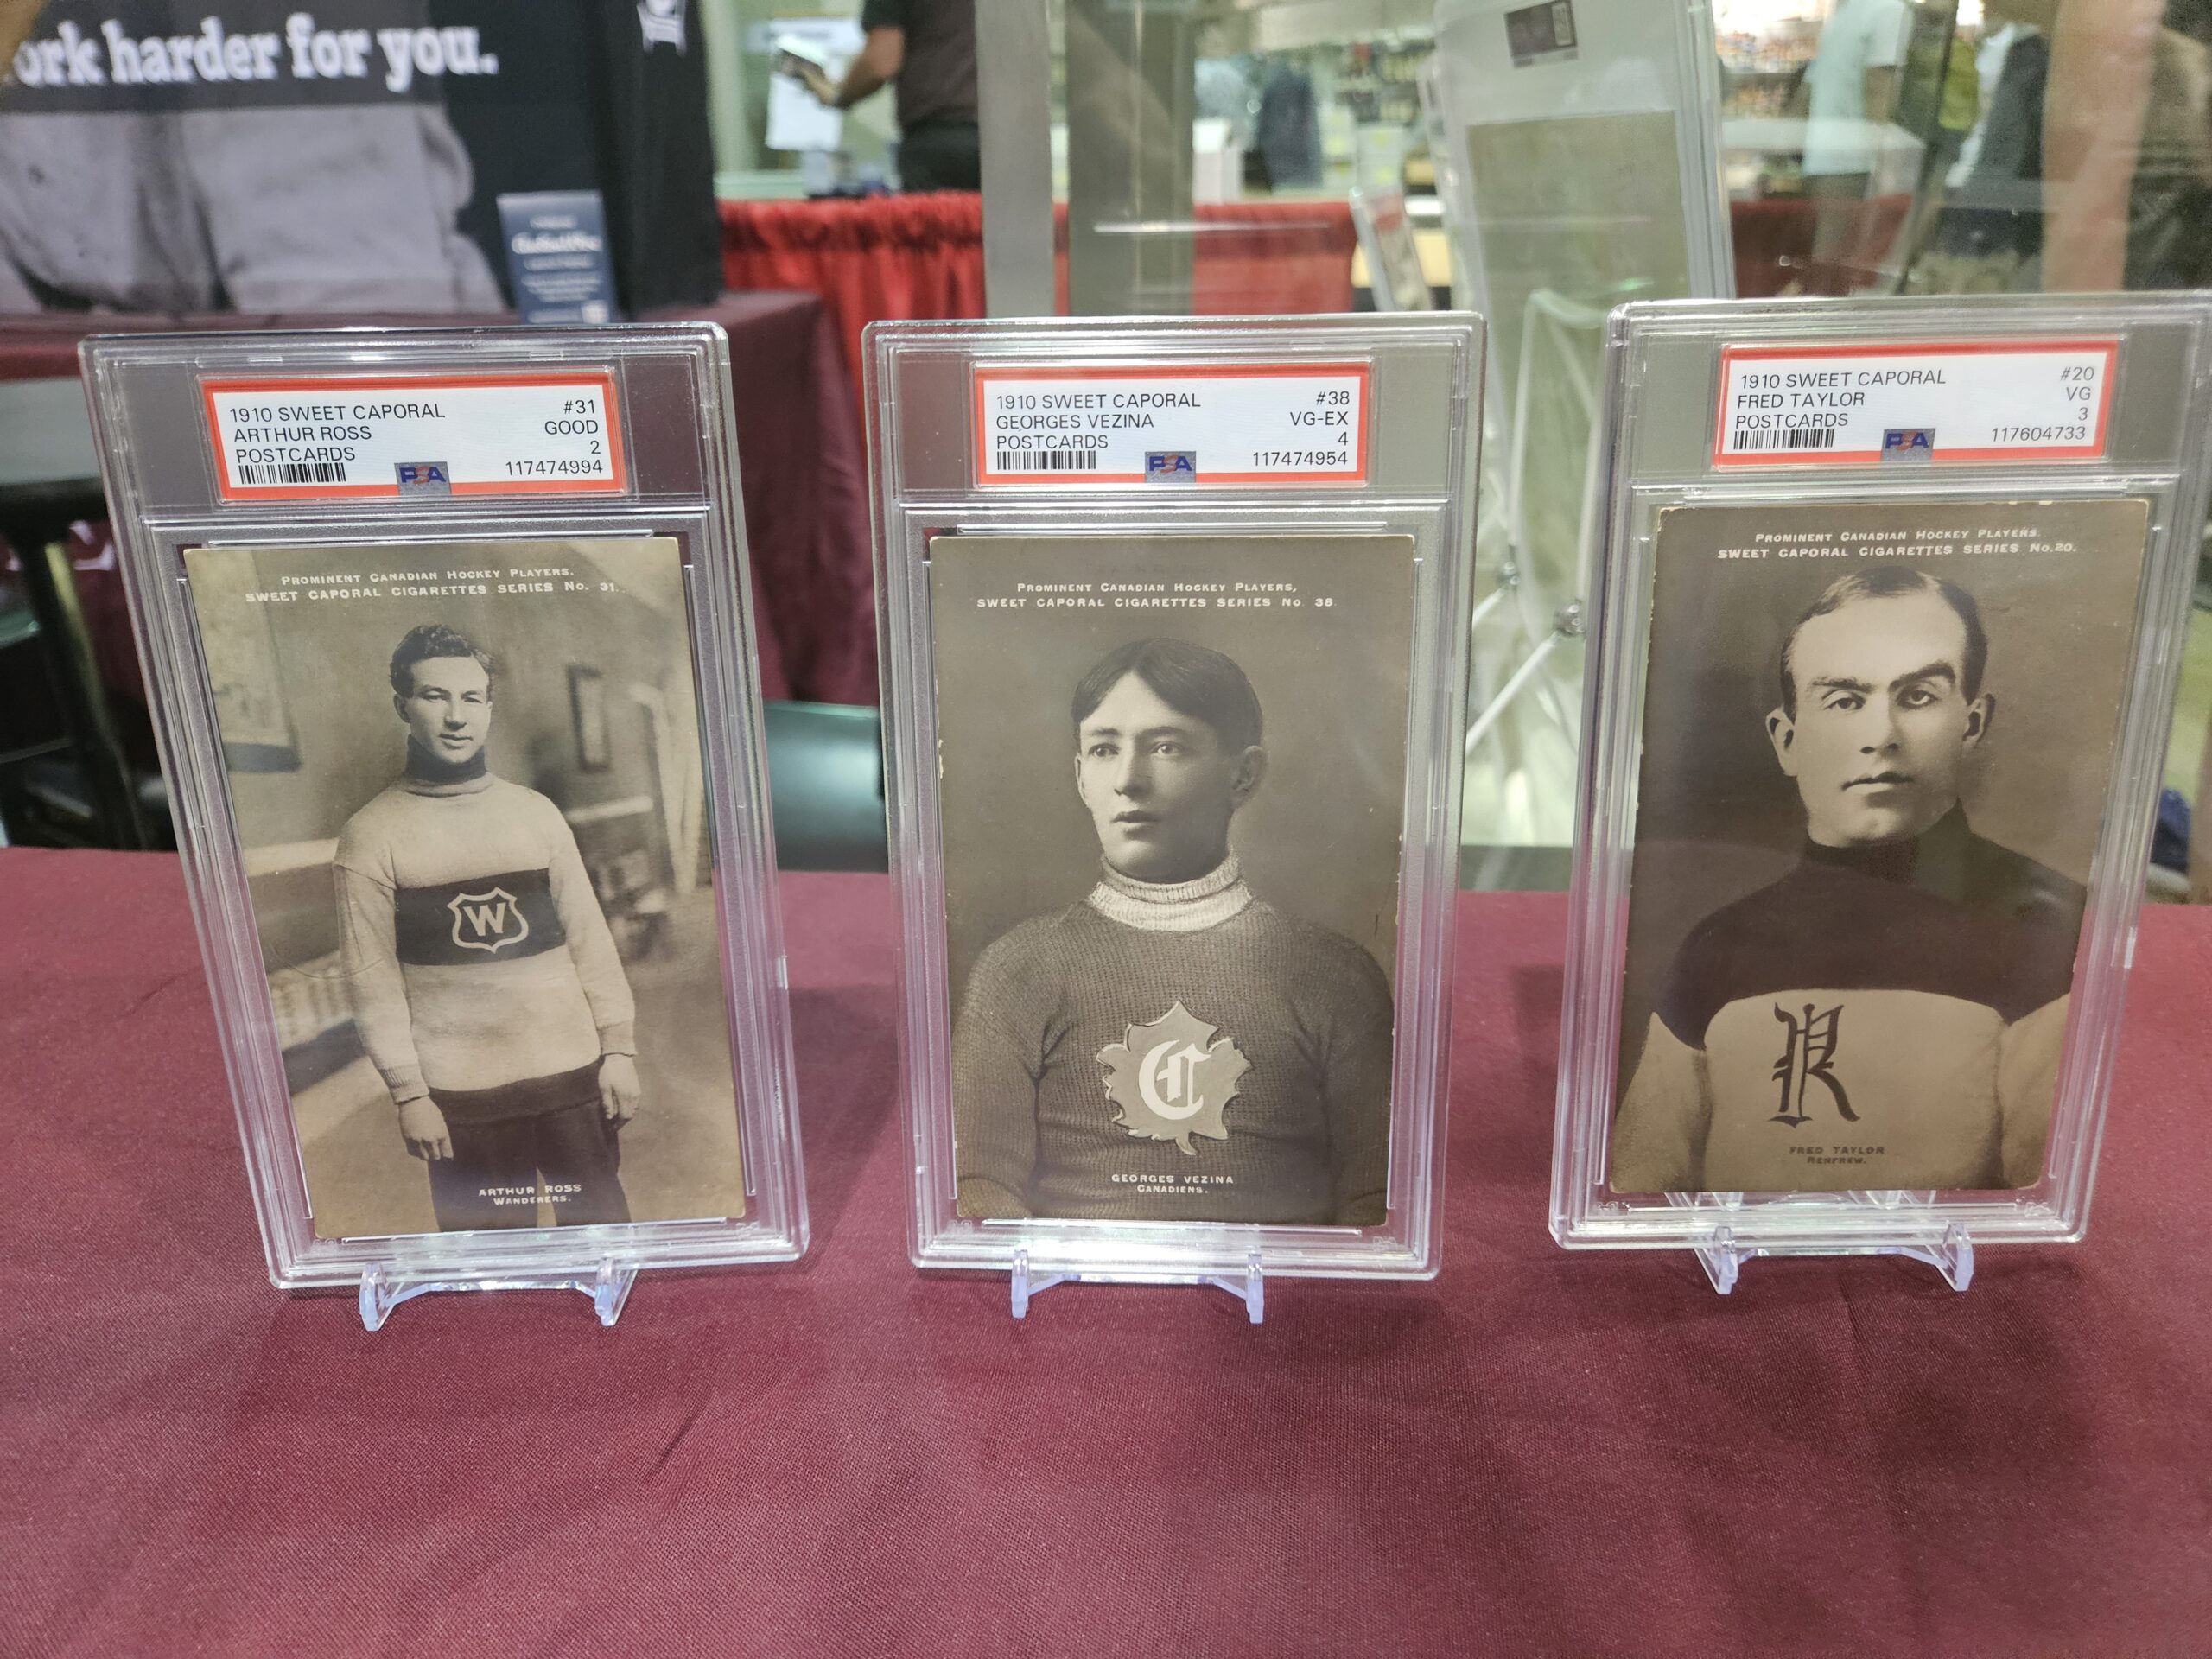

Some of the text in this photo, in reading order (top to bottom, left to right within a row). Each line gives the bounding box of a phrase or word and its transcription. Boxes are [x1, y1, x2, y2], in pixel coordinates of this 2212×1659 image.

[2, 11, 499, 93] ork harder for you.
[1740, 370, 1946, 388] 1910 SWEET CAPORAL
[2060, 367, 2094, 382] #20
[997, 393, 1201, 410] 1910 SWEET CAPORAL
[1316, 391, 1350, 405] #38
[1737, 392, 1865, 409] FRED TAYLOR
[2065, 387, 2091, 402] VG
[230, 403, 446, 423] 1910 SWEET CAPORAL
[563, 400, 595, 415] #31
[2078, 407, 2088, 422] 3
[995, 413, 1154, 429] GEORGES VEZINA
[1290, 411, 1349, 426] VG-EX
[1735, 413, 1848, 429] POSTCARDS
[234, 426, 372, 443] ARTHUR ROSS
[544, 420, 599, 435] GOOD
[1991, 426, 2086, 442] 117604733
[997, 435, 1108, 449] POSTCARDS
[1338, 432, 1348, 446] 4
[1885, 431, 1929, 449] PSA
[236, 447, 356, 463] POSTCARDS
[590, 441, 601, 454] 2
[1148, 454, 1192, 473] PSA
[1253, 452, 1348, 466] 117474954
[399, 467, 447, 485] PSA
[505, 460, 603, 476] 117474994
[1717, 549, 1770, 559] SWEET
[1778, 547, 1848, 558] CAPORAL
[1859, 545, 1953, 556] CIGARETTES
[1963, 543, 2019, 554] SERIES
[245, 591, 297, 602] SWEET
[308, 588, 381, 599] CAPORAL
[391, 585, 486, 596] CIGARETTES
[497, 583, 553, 594] SERIES
[976, 599, 1027, 607] SWEET
[1037, 598, 1105, 607] CAPORAL
[1114, 598, 1207, 607] CIGARETTES
[1217, 598, 1271, 607] SERIES
[463, 902, 506, 937] W
[1789, 1146, 1885, 1154] FRED TAYLOR
[1111, 1174, 1234, 1184] GEORGES VEZINA
[479, 1184, 582, 1196] ARTHUR ROSS
